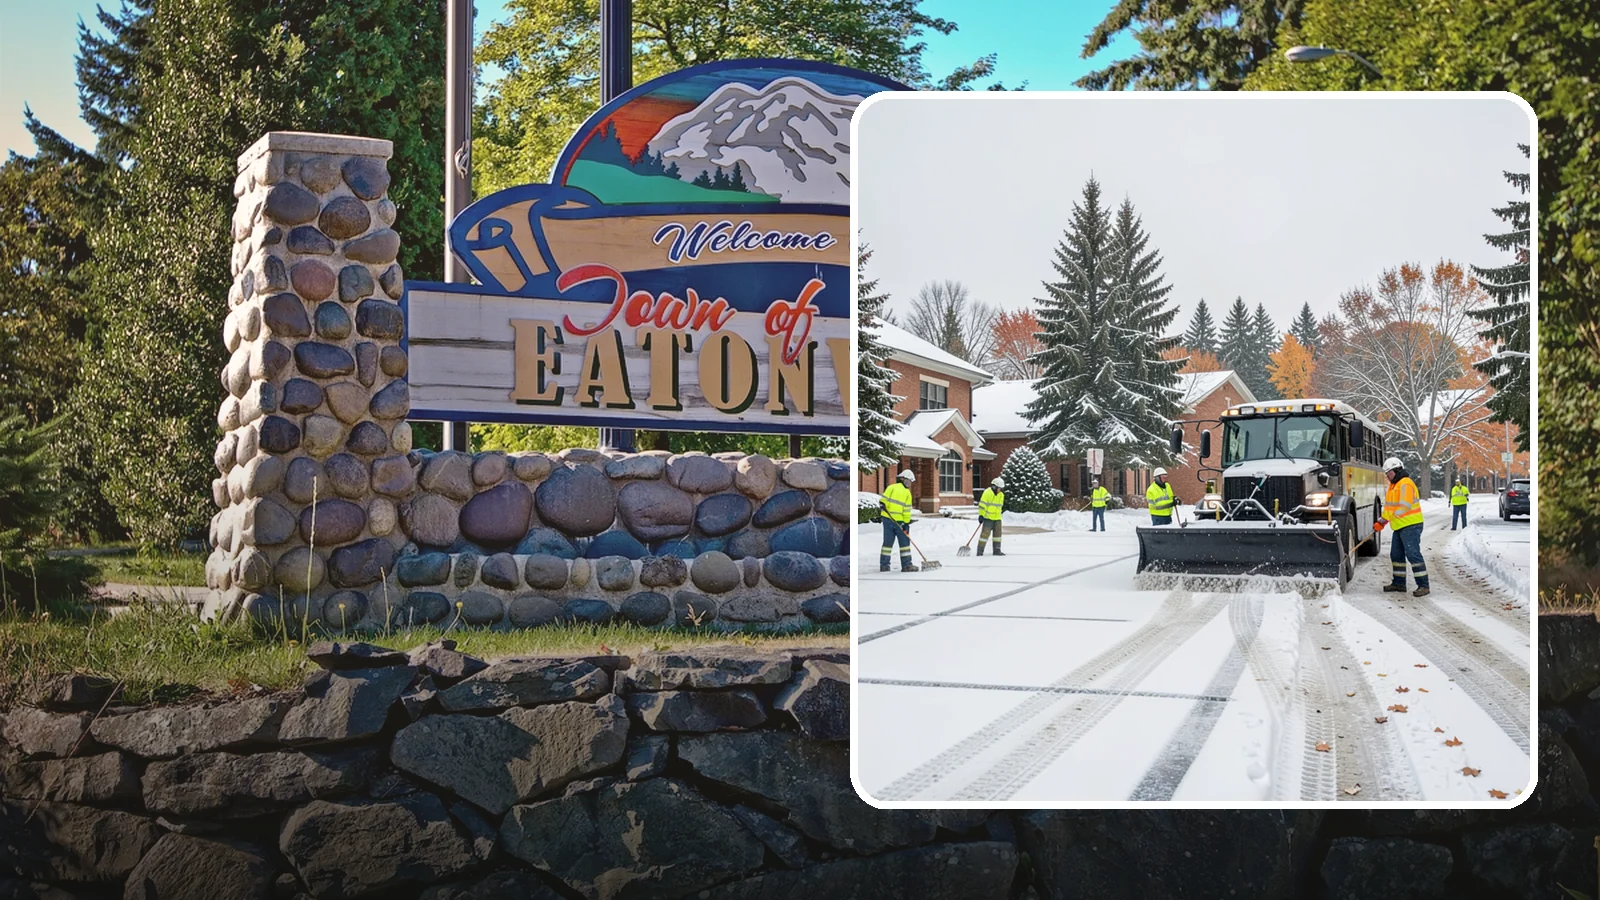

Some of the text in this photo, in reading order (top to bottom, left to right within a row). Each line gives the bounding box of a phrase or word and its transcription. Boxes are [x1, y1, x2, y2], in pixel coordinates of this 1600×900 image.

[653, 221, 836, 262] Welcome
[557, 264, 826, 365] Town of
